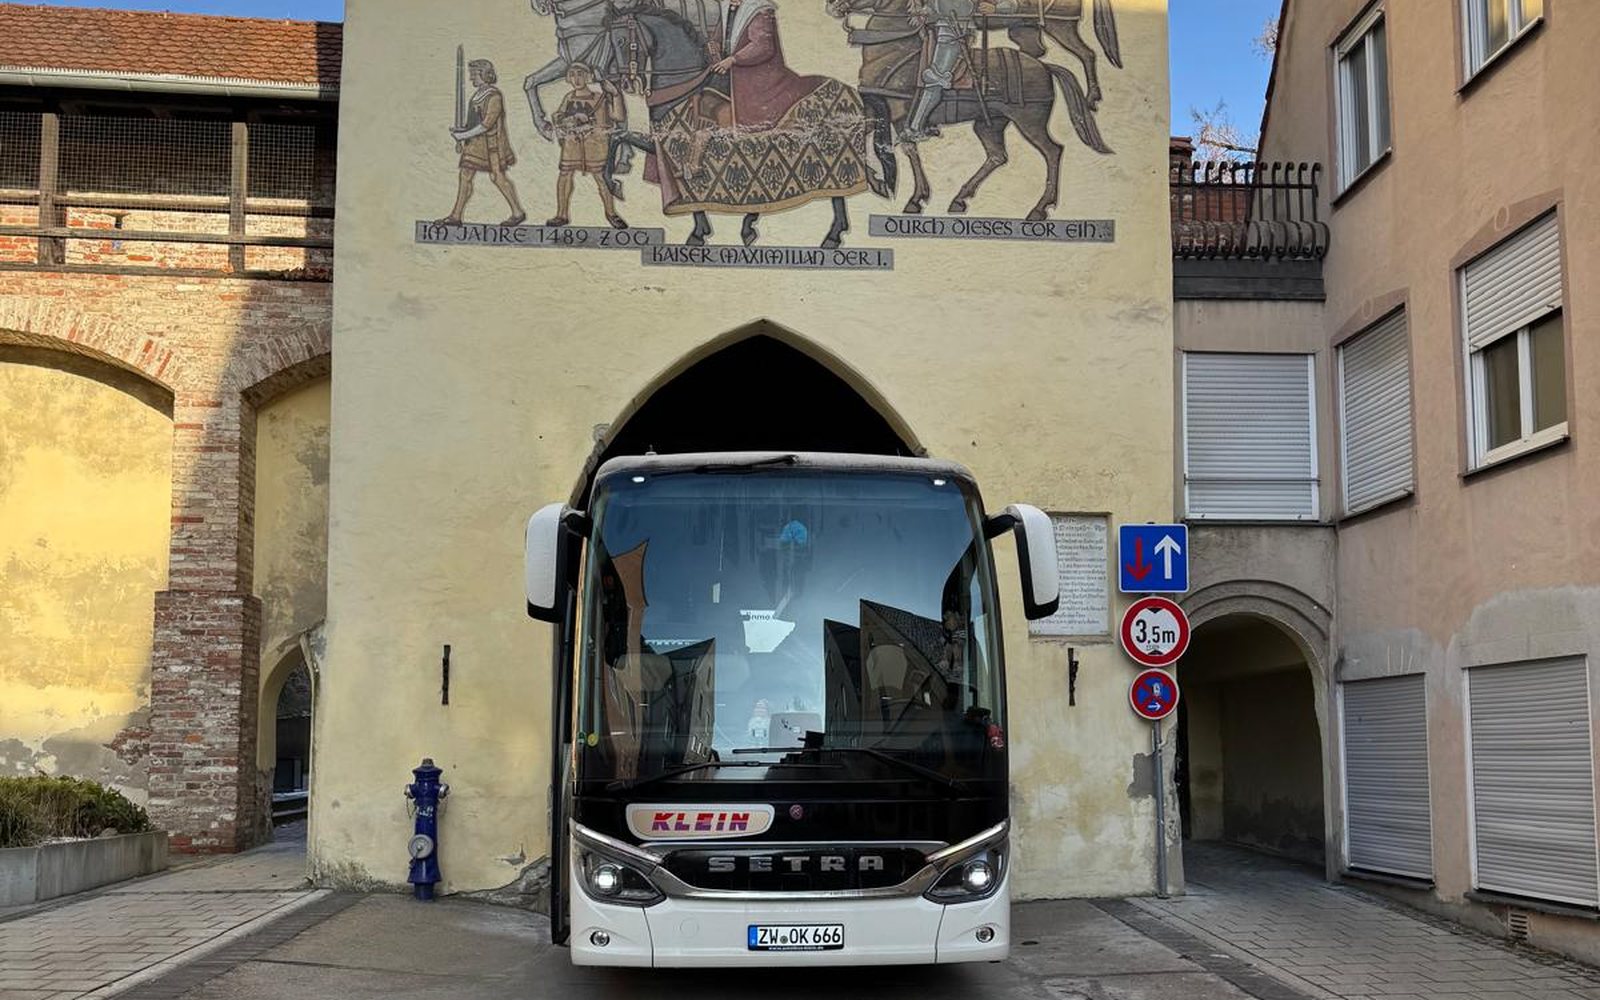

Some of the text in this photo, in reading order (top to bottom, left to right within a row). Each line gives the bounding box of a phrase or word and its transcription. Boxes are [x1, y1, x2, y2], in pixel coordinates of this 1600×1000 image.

[422, 224, 650, 246] IM JAHRE 1489 ZOG
[884, 217, 945, 235] DURCH
[952, 218, 1013, 236] DIESES
[1020, 221, 1058, 237] TOR
[652, 246, 714, 263] KAISER
[719, 249, 825, 266] MAXIMILIAN
[833, 249, 875, 266] DER
[652, 813, 750, 831] KLEIN
[708, 856, 884, 872] SETRA
[759, 927, 841, 944] ZW OK 666
